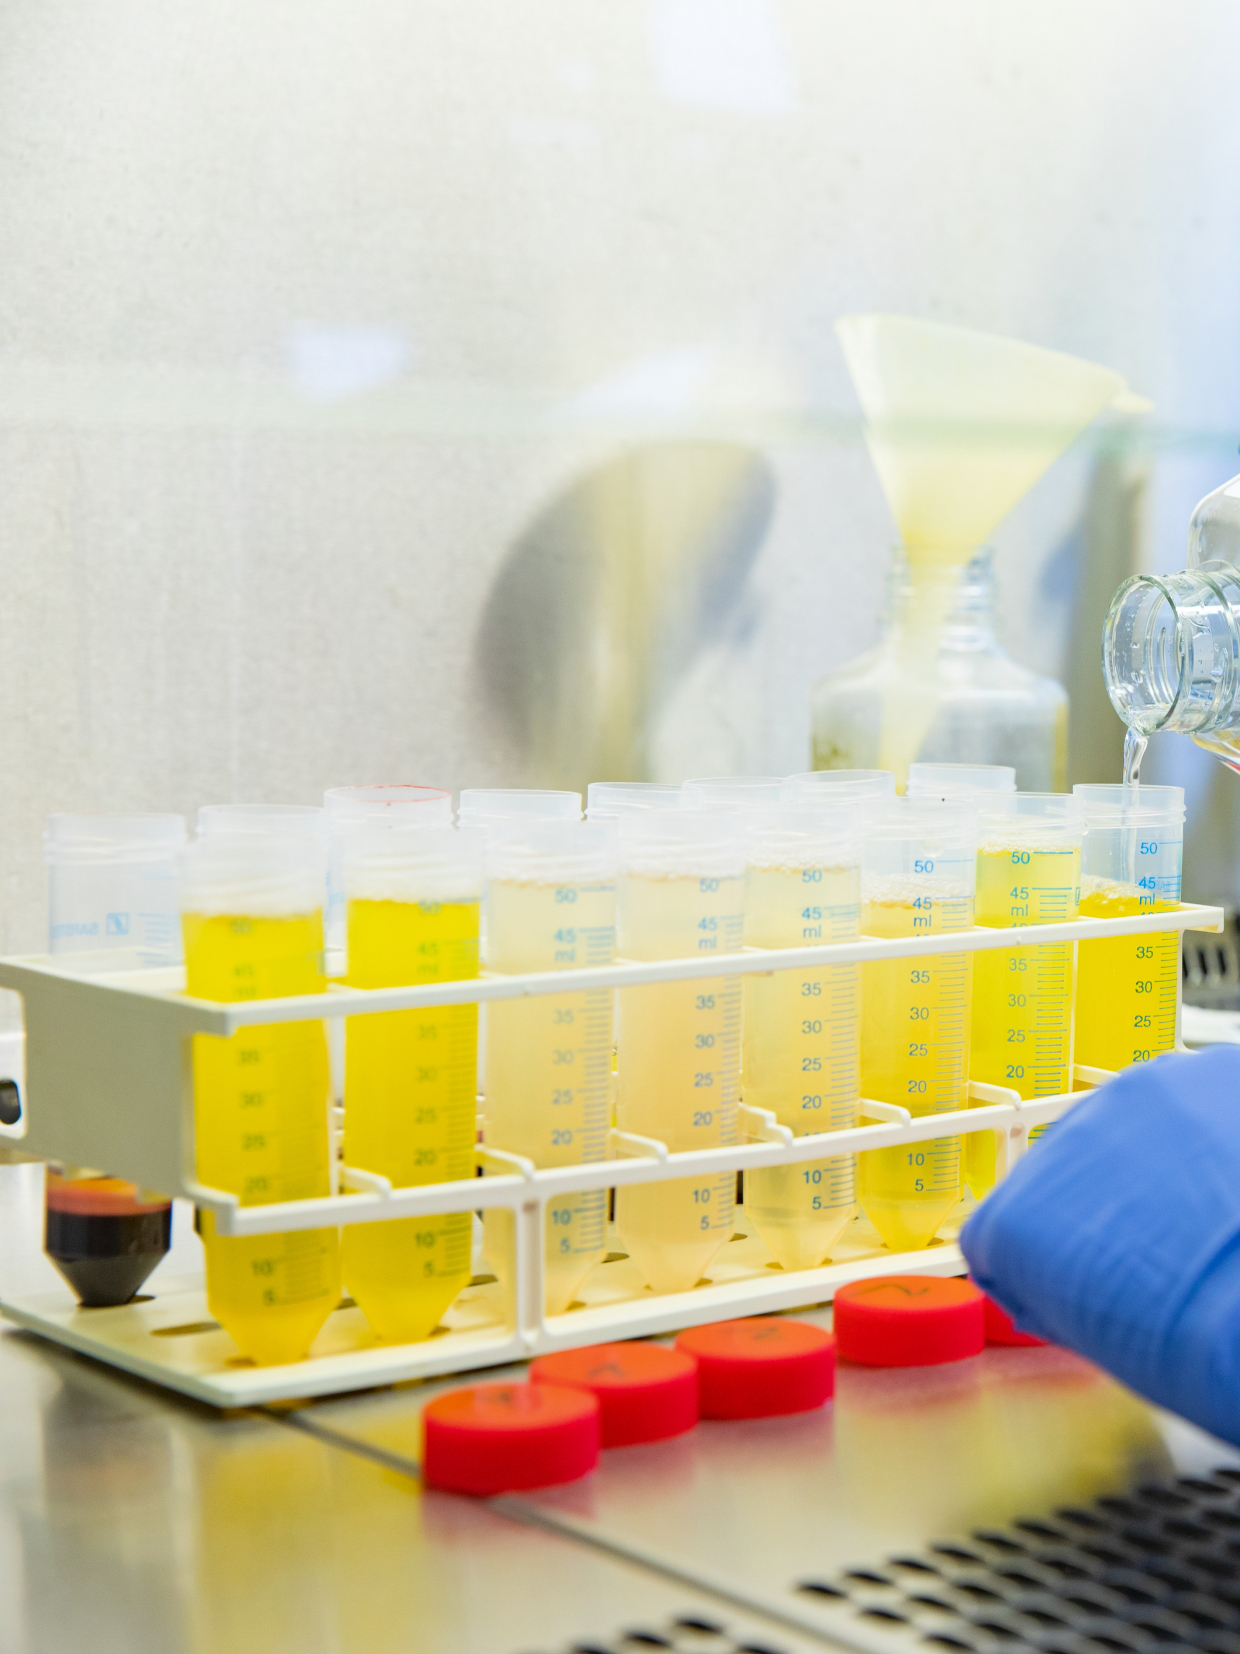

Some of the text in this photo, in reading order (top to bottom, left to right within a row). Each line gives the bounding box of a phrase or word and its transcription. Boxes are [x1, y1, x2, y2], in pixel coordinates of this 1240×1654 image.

[1140, 842, 1158, 854] 50
[1011, 852, 1030, 864] 50
[914, 860, 934, 874] 50
[802, 870, 822, 884] 50
[1138, 876, 1156, 890] 45
[699, 878, 719, 893] 50
[554, 888, 578, 904] 50
[1010, 887, 1029, 900] 45
[1140, 893, 1156, 905] ml
[912, 897, 932, 910] 45
[1011, 904, 1028, 916] ml
[802, 906, 822, 920] 45
[698, 916, 718, 932] 45
[913, 914, 932, 927] ml
[553, 928, 576, 944] 45
[802, 924, 822, 938] ml
[698, 935, 718, 950] ml
[554, 948, 576, 962] ml
[1136, 946, 1154, 959] 35
[1008, 958, 1028, 972] 35
[910, 970, 930, 984] 35
[802, 982, 822, 996] 35
[1135, 981, 1152, 993] 30
[696, 994, 716, 1010] 35
[1008, 994, 1027, 1008] 30
[552, 1008, 574, 1024] 35
[910, 1007, 930, 1020] 30
[802, 1020, 822, 1034] 30
[1134, 1015, 1151, 1028] 25
[694, 1034, 715, 1049] 30
[1006, 1029, 1026, 1043] 25
[908, 1044, 928, 1056] 25
[1133, 1050, 1150, 1062] 20
[552, 1050, 574, 1066] 30
[802, 1058, 822, 1072] 25
[1006, 1065, 1024, 1078] 20
[694, 1072, 714, 1088] 25
[908, 1080, 927, 1093] 20
[552, 1090, 574, 1106] 25
[802, 1096, 822, 1110] 20
[692, 1111, 712, 1126] 20
[552, 1130, 572, 1146] 20
[414, 1150, 436, 1166] 20
[906, 1153, 925, 1166] 10
[802, 1170, 822, 1184] 10
[914, 1178, 924, 1192] 5
[692, 1188, 711, 1204] 10
[812, 1196, 822, 1210] 5
[552, 1209, 572, 1225] 10
[700, 1215, 710, 1230] 5
[414, 1231, 436, 1248] 10
[560, 1238, 570, 1254] 5
